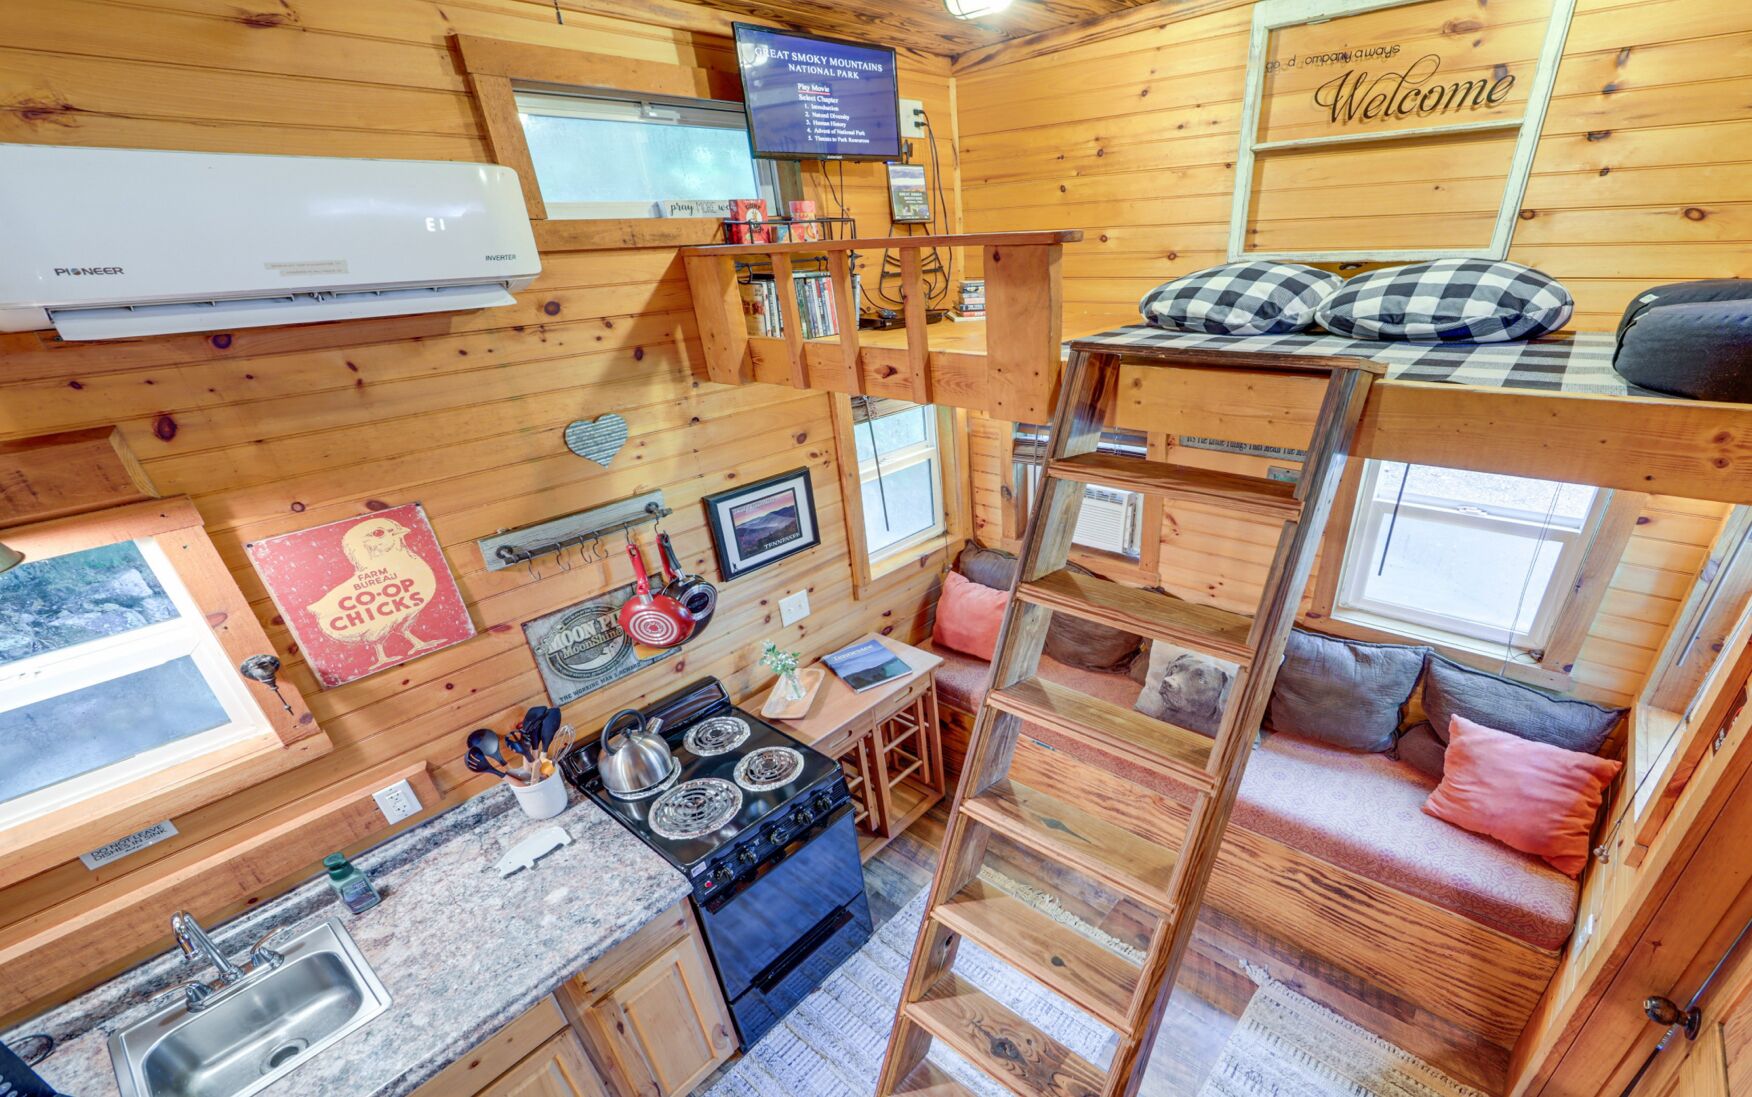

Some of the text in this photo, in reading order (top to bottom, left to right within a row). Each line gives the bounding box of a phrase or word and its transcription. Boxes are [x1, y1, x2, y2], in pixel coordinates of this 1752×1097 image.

[755, 47, 883, 72] GREAT SMOKY MOUNTAINS
[789, 64, 859, 79] NATIONAL PARK
[797, 83, 810, 92] Play
[1314, 54, 1516, 123] Welcome
[817, 95, 839, 104] Chapter
[670, 202, 694, 216] pray
[54, 267, 124, 276] PIONEER
[764, 532, 800, 550] TENNESSEE
[353, 573, 398, 591] BUREAU
[358, 568, 388, 581] FARM
[338, 578, 414, 611] CO-OP
[329, 592, 424, 631] CHICKS
[547, 620, 597, 653] MOON
[597, 612, 619, 632] PI
[560, 693, 572, 702] THE
[573, 681, 599, 696] WORKING
[619, 662, 642, 674] REWARD
[91, 824, 163, 857] DO NOT LEAVE
[93, 829, 167, 862] DISHES IN SINK
